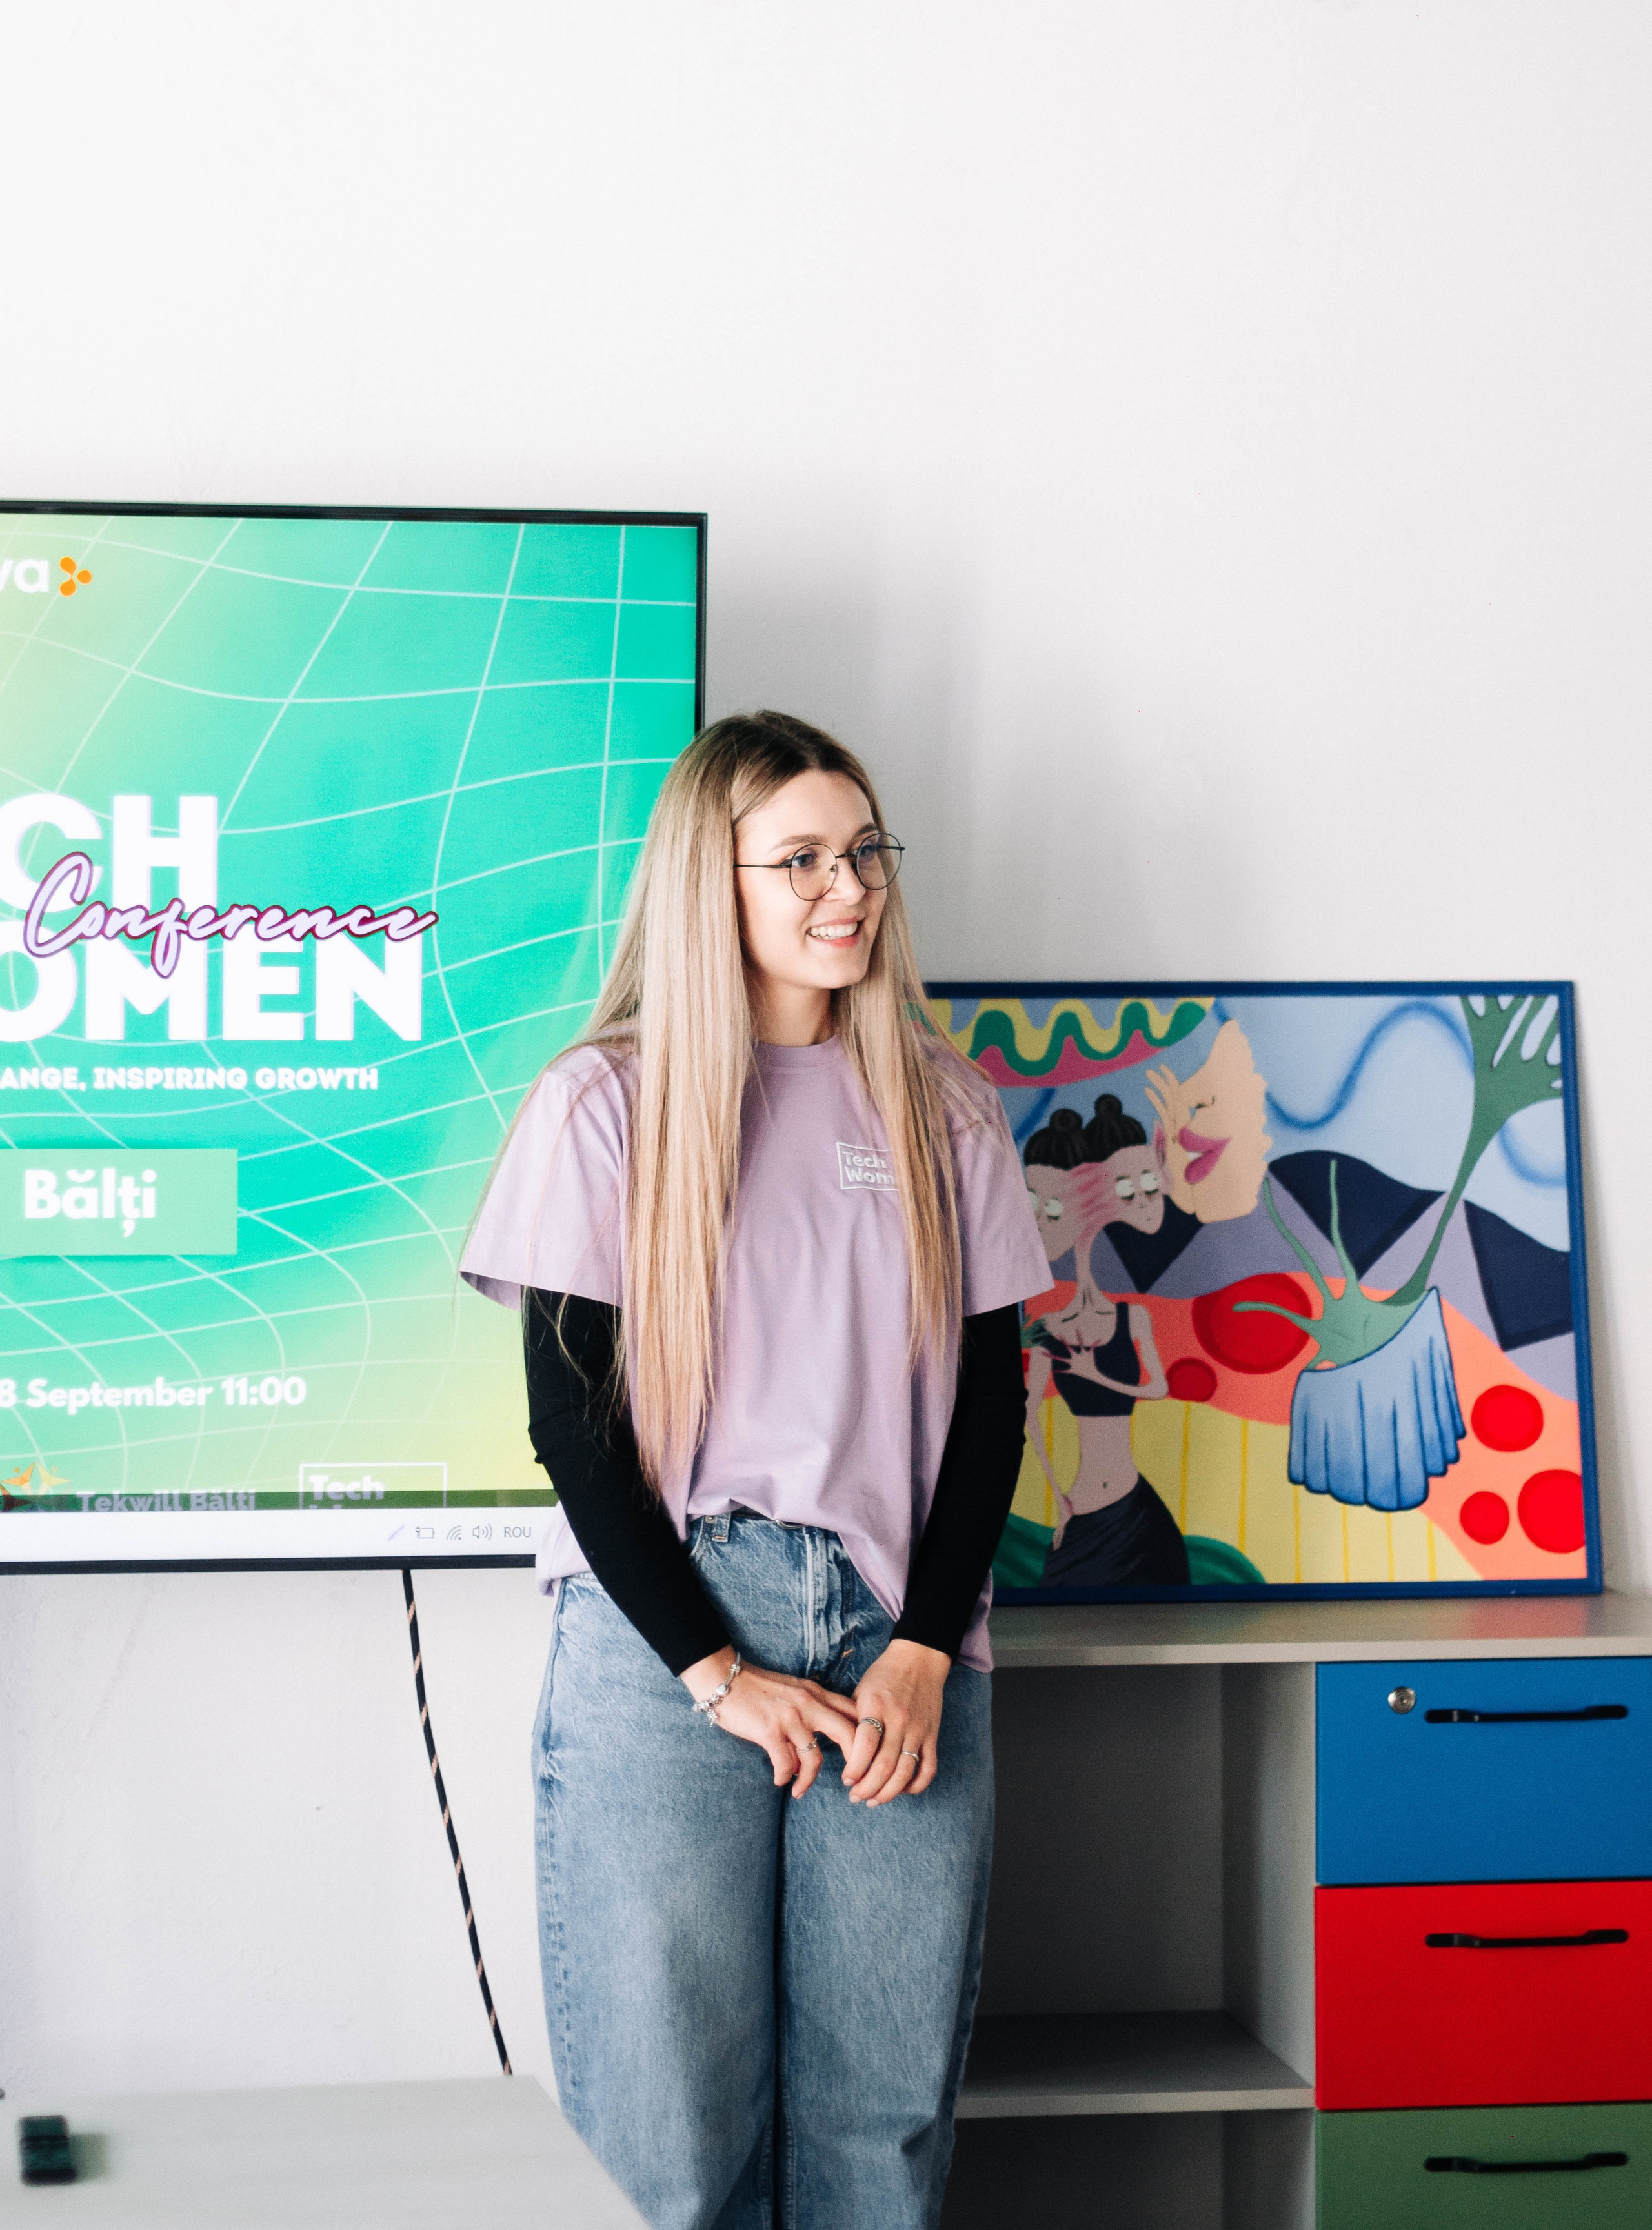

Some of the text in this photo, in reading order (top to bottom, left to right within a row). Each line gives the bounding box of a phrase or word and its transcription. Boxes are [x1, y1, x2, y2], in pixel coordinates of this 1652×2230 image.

[0, 794, 218, 912] CH
[23, 852, 439, 978] Conference
[0, 920, 423, 1042] OMEN
[93, 1067, 247, 1090] INSPIRING
[254, 1067, 378, 1090] GROWTH
[842, 1150, 887, 1168] Tech
[24, 1168, 157, 1238] Bălți
[26, 1378, 213, 1415] September
[221, 1376, 307, 1405] 11:00
[76, 1490, 181, 1512] Tekwill
[308, 1474, 385, 1500] Tech
[504, 1527, 532, 1538] ROU
